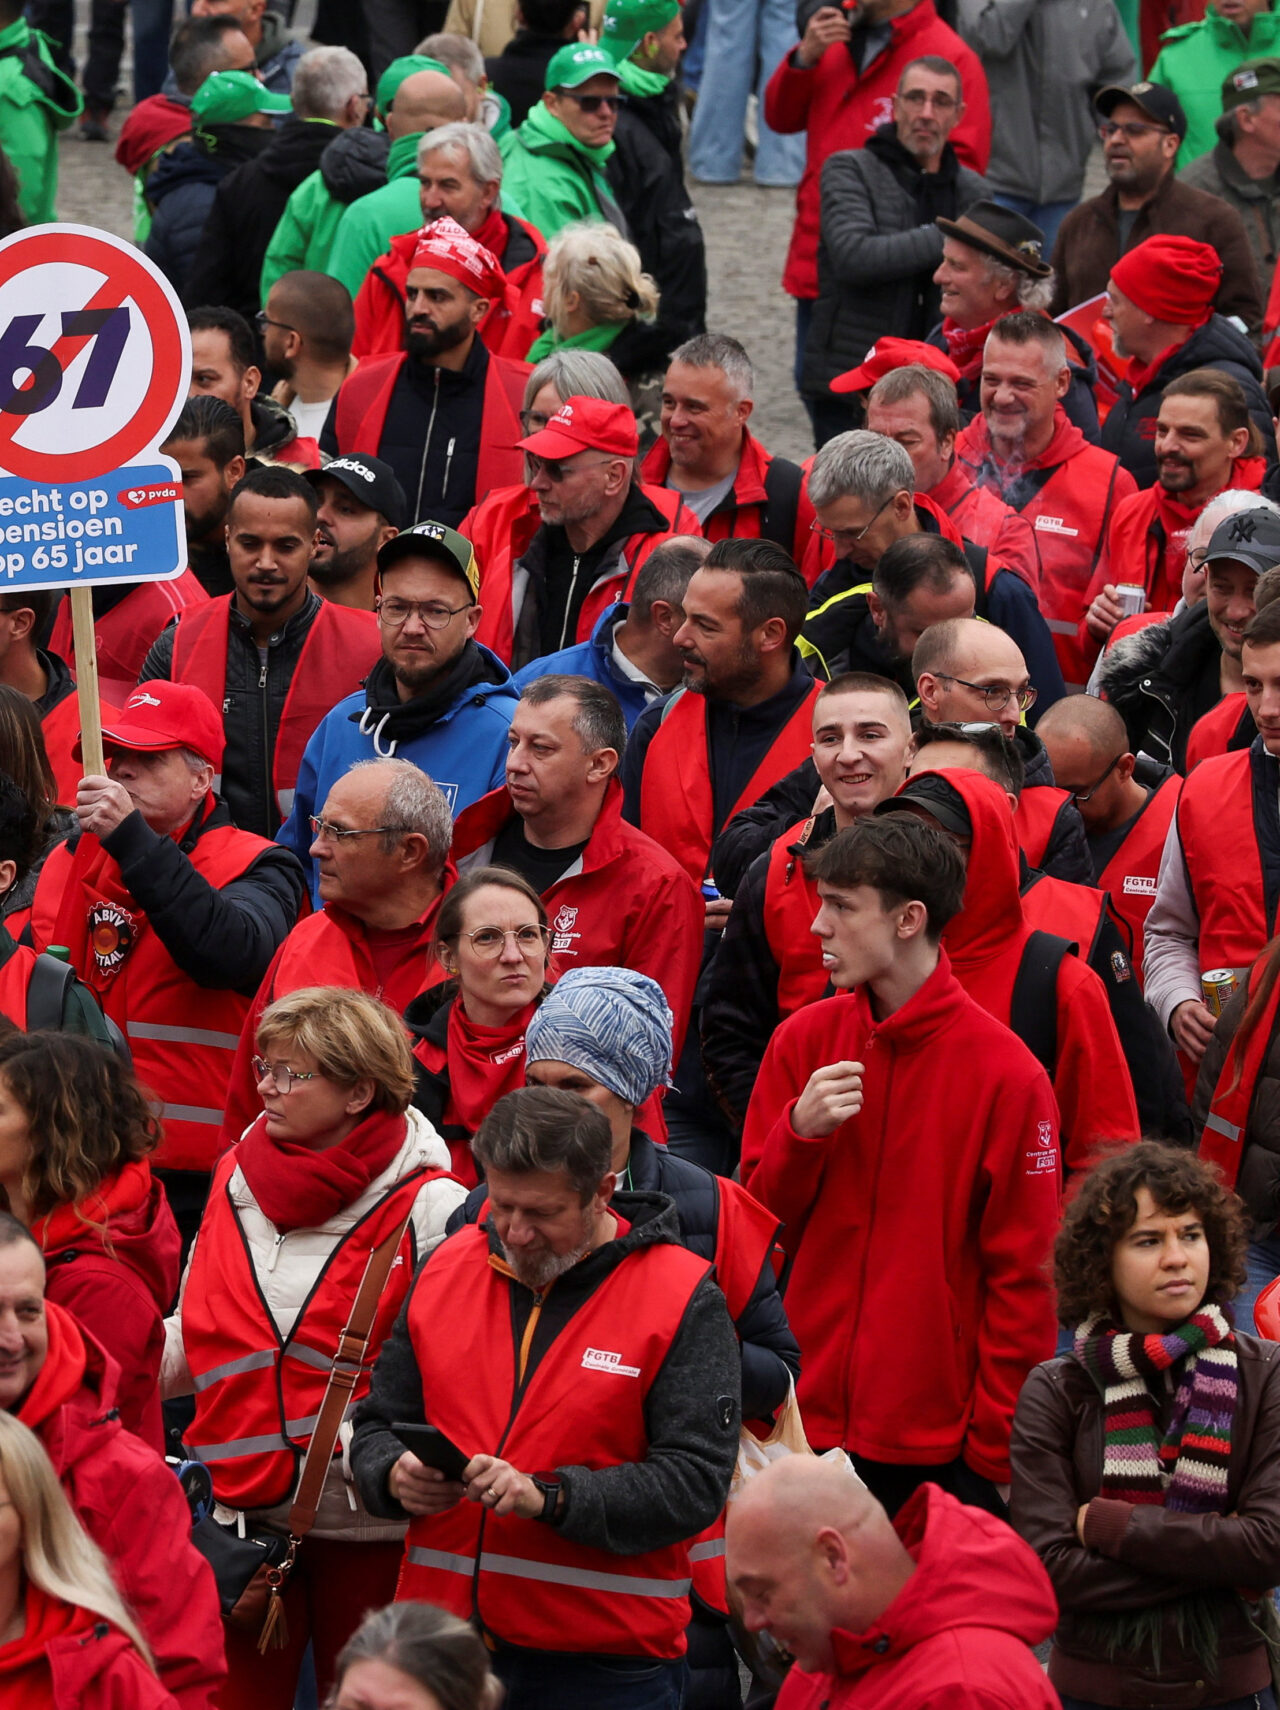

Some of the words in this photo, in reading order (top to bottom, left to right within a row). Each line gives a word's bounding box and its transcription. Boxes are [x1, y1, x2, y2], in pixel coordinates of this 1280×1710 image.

[69, 489, 109, 515] op
[148, 488, 176, 500] pvda
[31, 544, 69, 570] 65
[72, 541, 138, 573] jaar
[1125, 878, 1153, 887] FGTB
[94, 909, 125, 927] ABVV
[587, 1350, 619, 1364] FGTB
